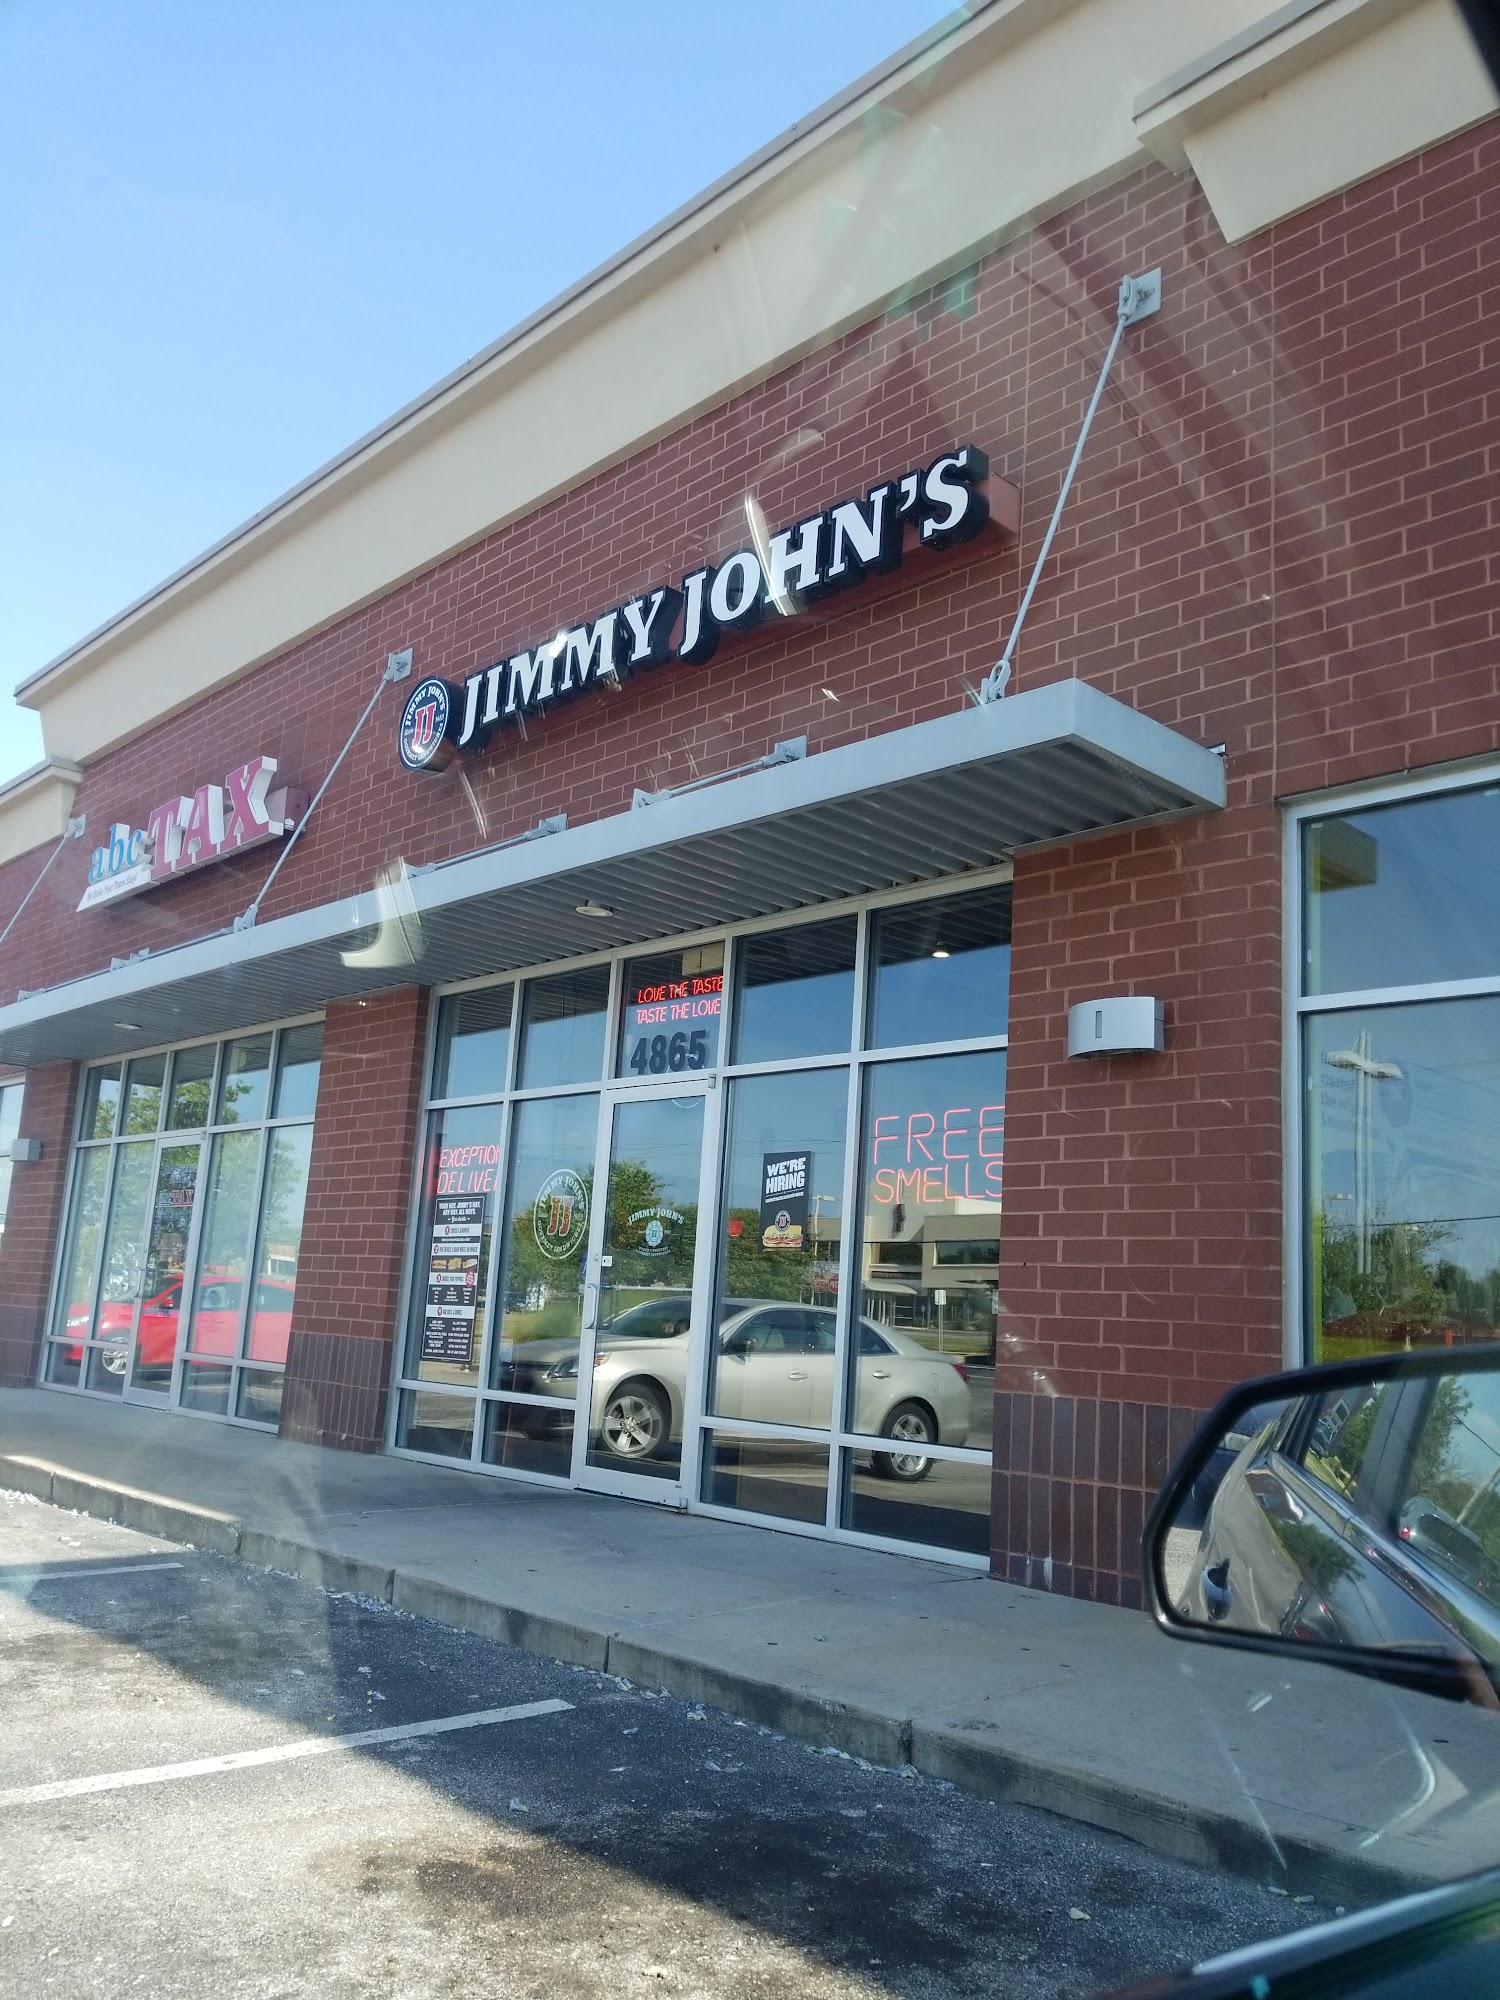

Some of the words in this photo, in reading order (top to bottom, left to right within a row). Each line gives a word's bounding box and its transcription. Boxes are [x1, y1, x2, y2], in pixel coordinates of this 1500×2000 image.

[459, 591, 664, 745] JIMMY
[678, 448, 971, 657] JOHN'S
[405, 688, 427, 726] JIMMY
[427, 685, 446, 711] JOHN'S
[88, 823, 143, 885] abc
[149, 756, 273, 881] TAX
[638, 986, 667, 1004] LOVE
[669, 981, 689, 999] THE
[692, 976, 724, 996] TASTE
[636, 1006, 668, 1025] TASTE
[670, 1002, 691, 1020] THE
[692, 998, 722, 1018] LOVE
[630, 1029, 707, 1075] 4865
[873, 1105, 1006, 1165] FREE
[437, 1168, 498, 1194] DELIVE
[765, 1170, 806, 1195] HIRING
[766, 1157, 807, 1177] WE'RE
[874, 1161, 1003, 1204] SMELLS
[539, 1175, 564, 1209] JIMMY
[565, 1176, 585, 1210] JOHN'S
[627, 1208, 656, 1226] JIMMY
[656, 1208, 685, 1225] JOHN'S
